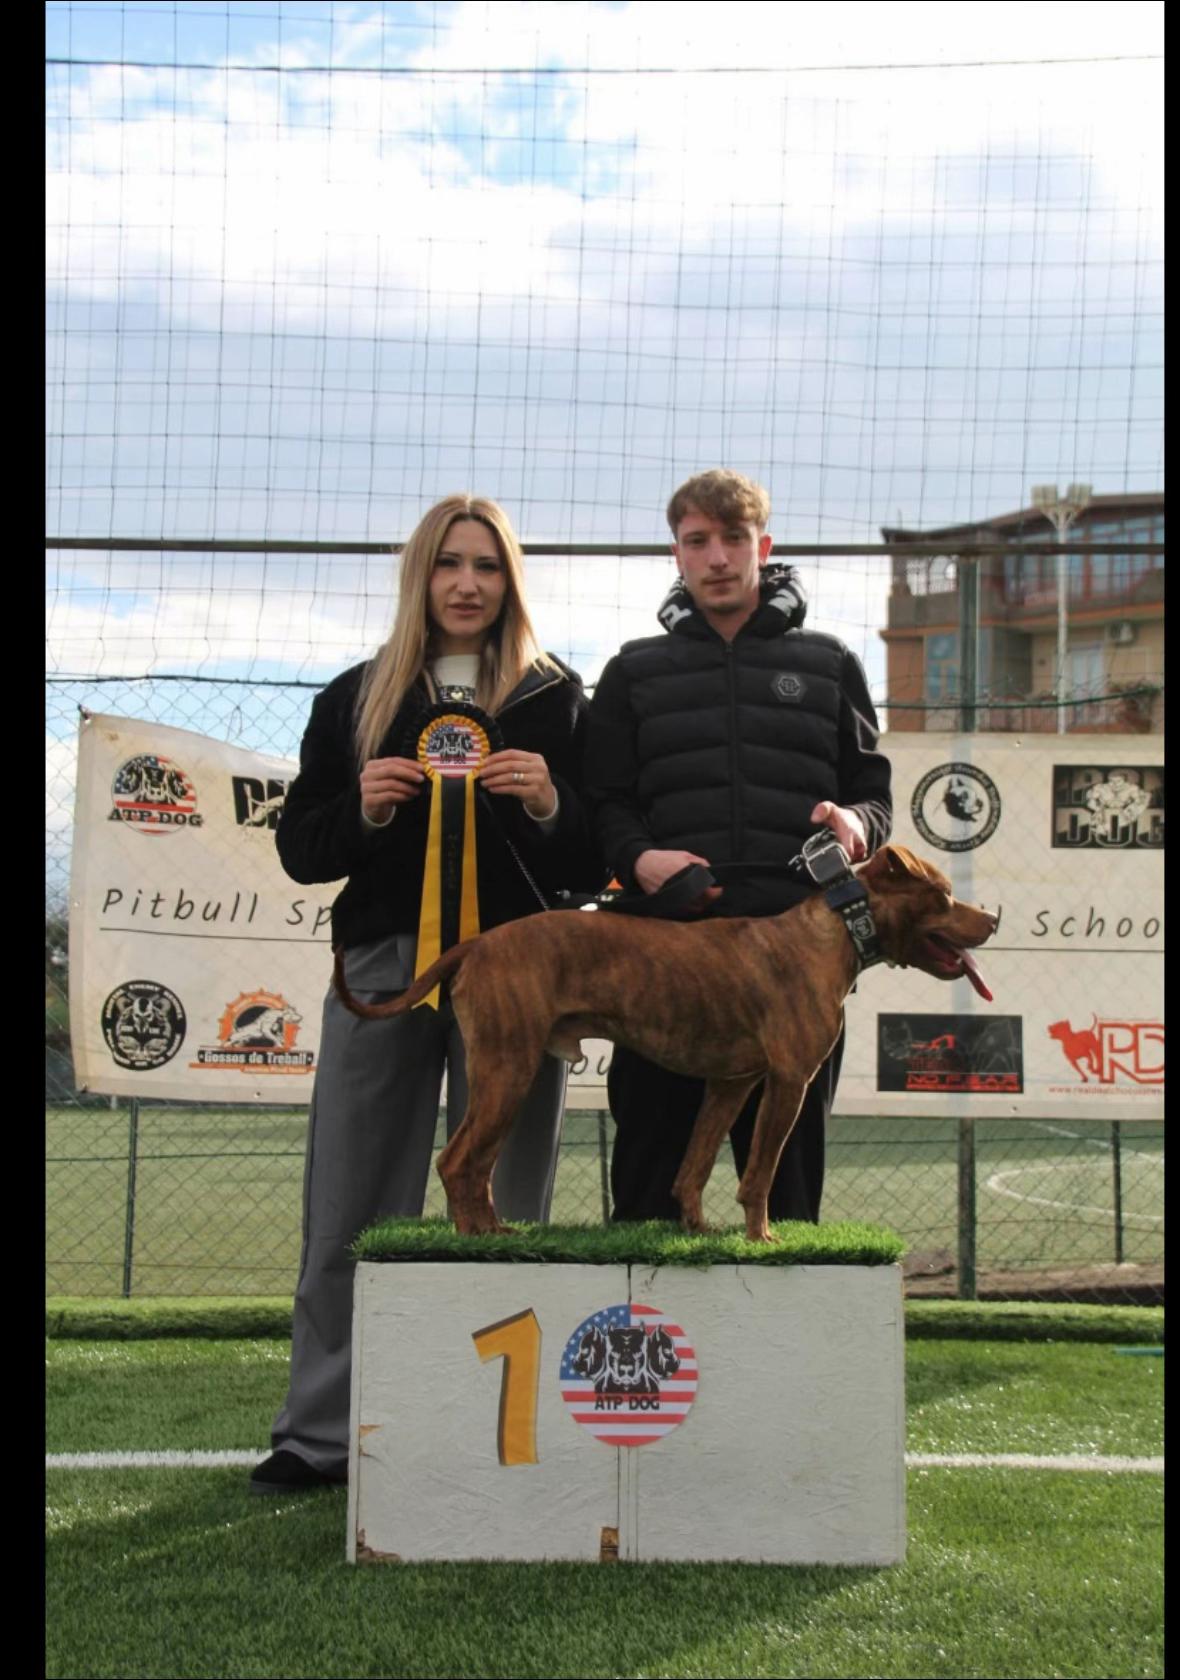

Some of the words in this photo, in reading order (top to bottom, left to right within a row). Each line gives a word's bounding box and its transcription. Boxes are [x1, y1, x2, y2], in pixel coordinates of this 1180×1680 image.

[108, 808, 154, 823] ATP
[157, 810, 204, 827] DOG
[102, 888, 258, 922] Pitbull
[248, 1051, 264, 1064] de
[472, 1307, 543, 1466] 1
[595, 1395, 623, 1410] ATP
[629, 1395, 660, 1410] DOG
